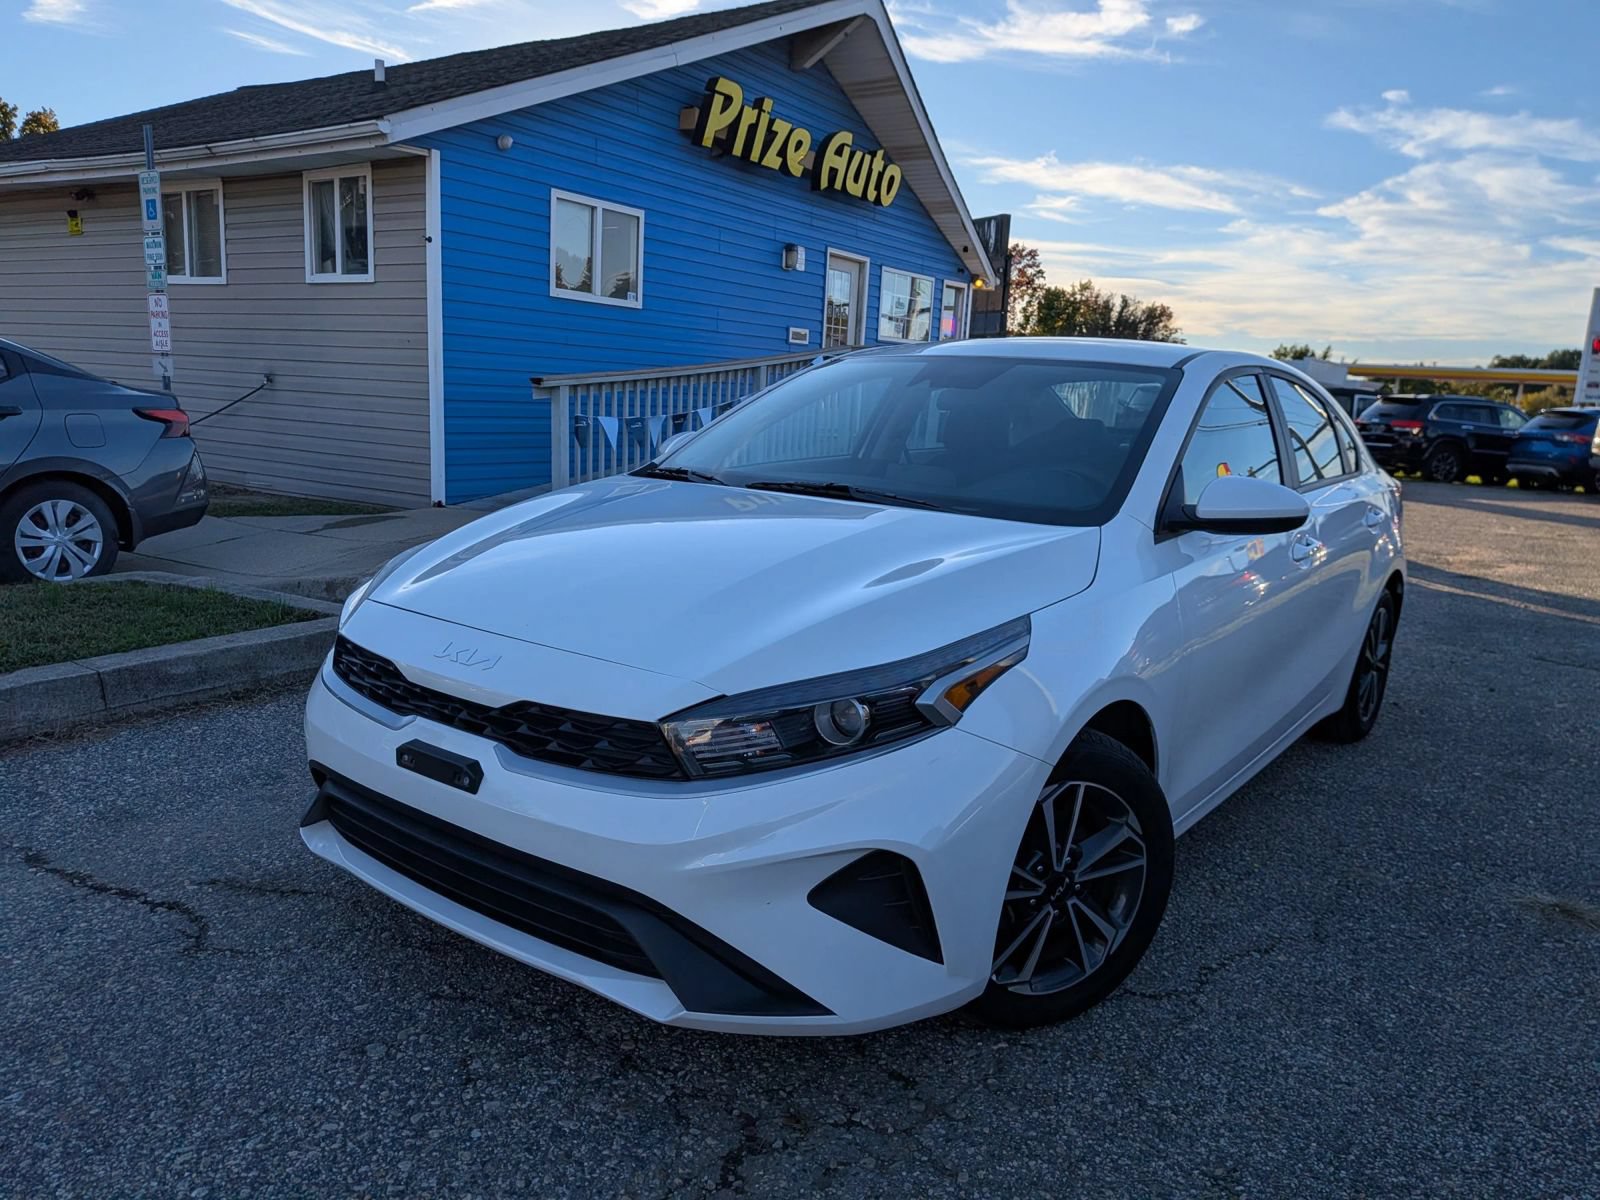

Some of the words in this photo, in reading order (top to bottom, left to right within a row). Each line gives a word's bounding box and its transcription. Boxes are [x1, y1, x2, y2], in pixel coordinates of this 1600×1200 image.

[700, 76, 812, 178] Prize
[820, 131, 902, 207] Auto
[151, 270, 162, 280] VAN
[154, 297, 163, 308] NO
[150, 310, 169, 320] PARKING
[153, 330, 169, 338] ACCESS
[155, 339, 169, 348] AISLE
